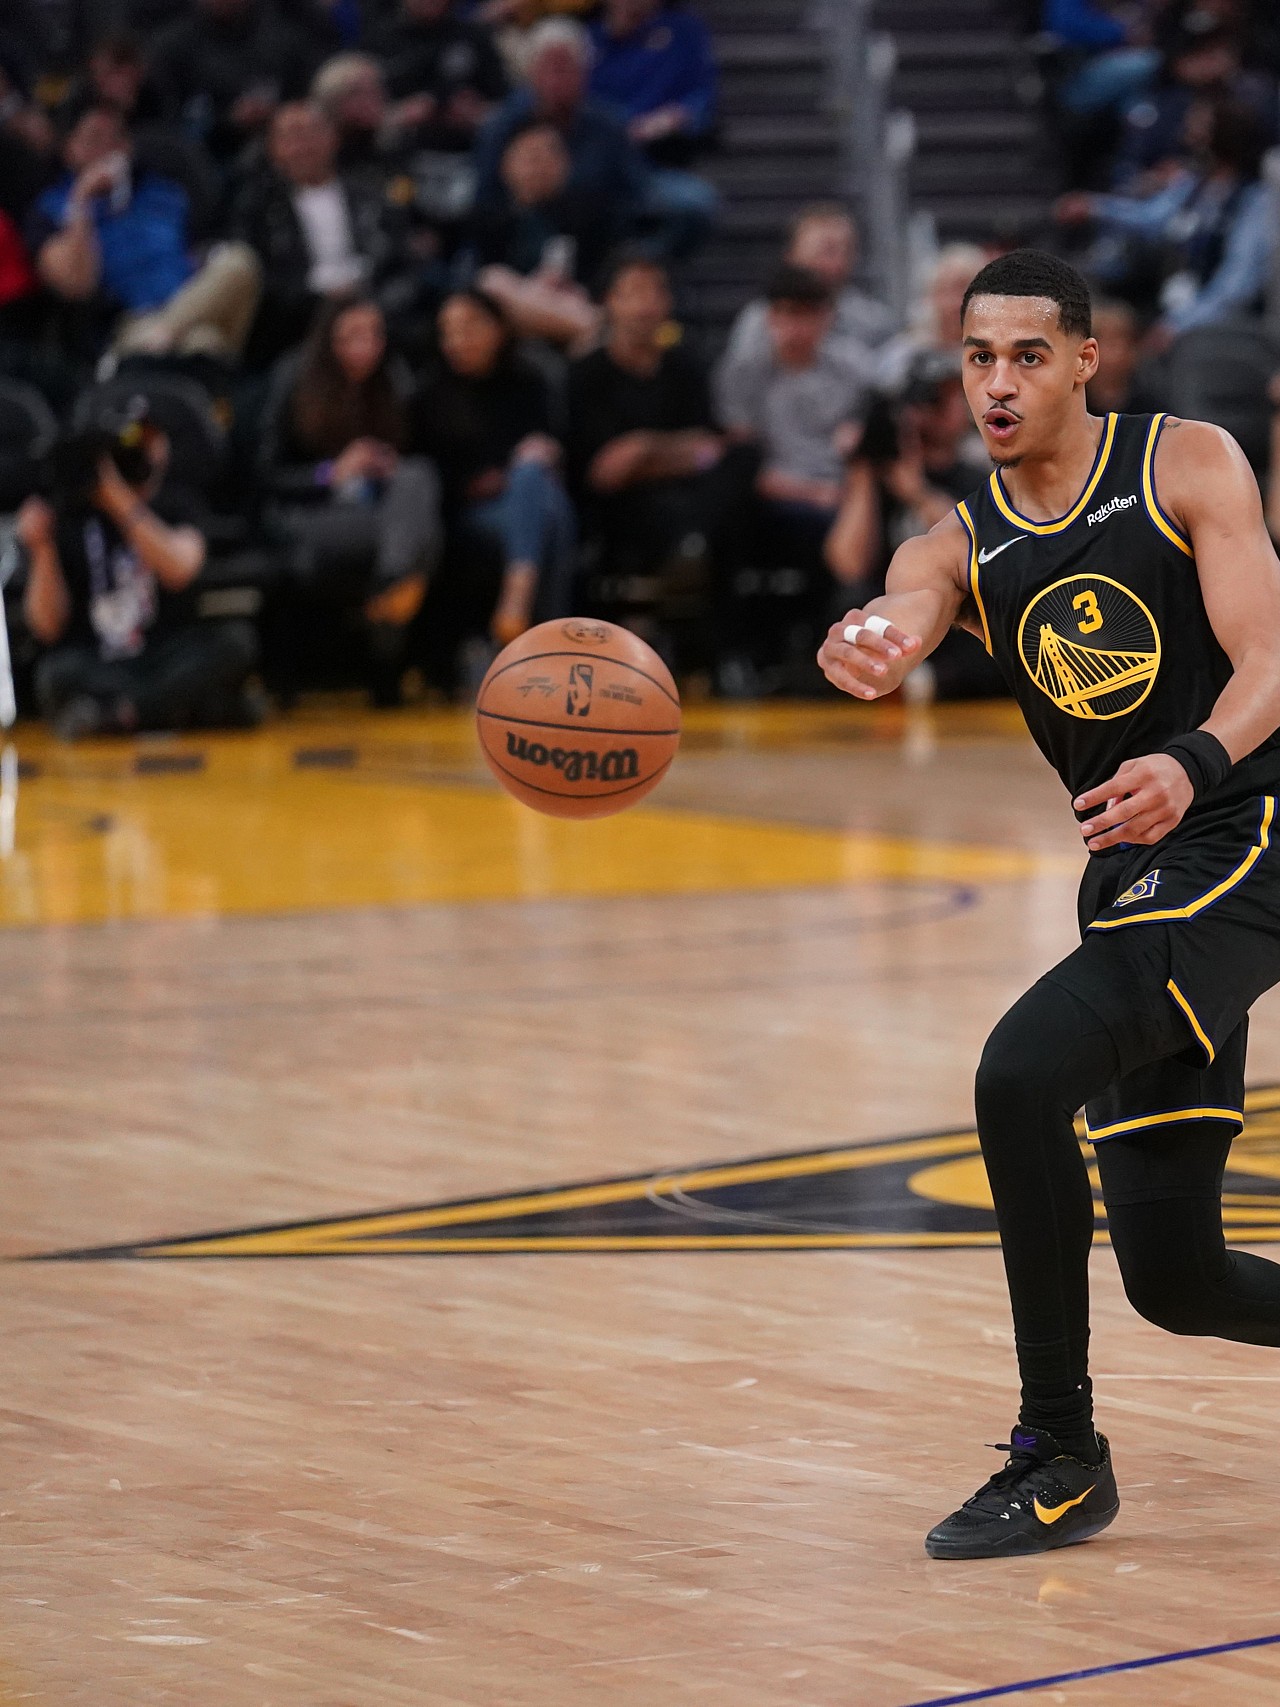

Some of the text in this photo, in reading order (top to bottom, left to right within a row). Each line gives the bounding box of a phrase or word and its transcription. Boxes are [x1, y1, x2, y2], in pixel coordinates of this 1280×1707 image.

[1086, 494, 1138, 527] Rakuten
[1072, 590, 1104, 635] 3
[506, 730, 640, 783] Wilson
